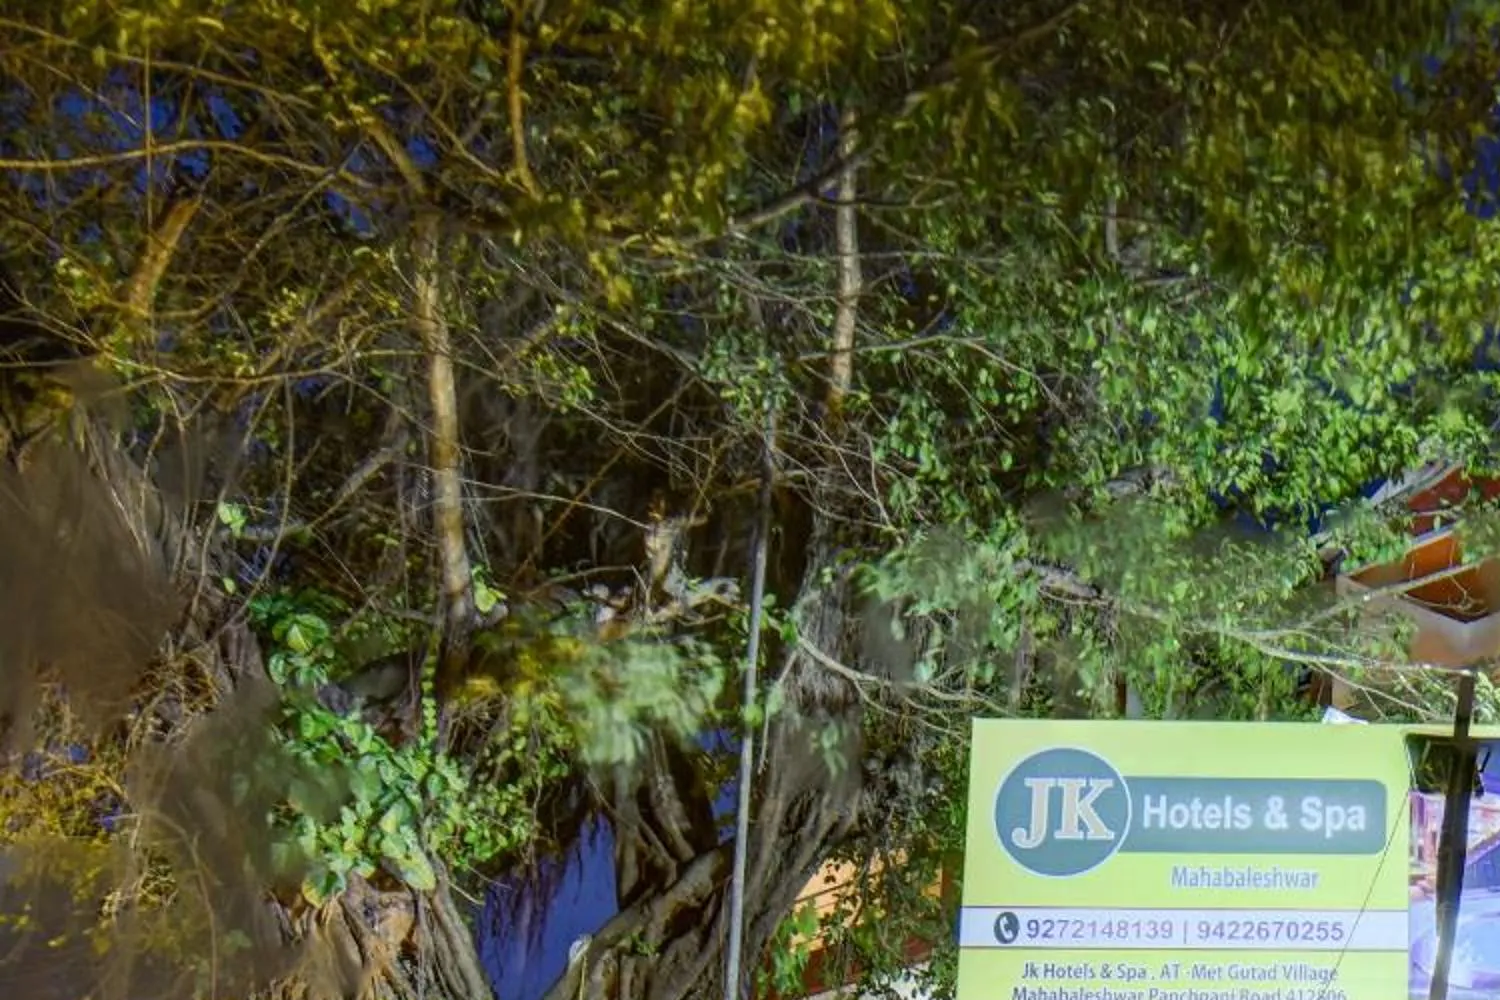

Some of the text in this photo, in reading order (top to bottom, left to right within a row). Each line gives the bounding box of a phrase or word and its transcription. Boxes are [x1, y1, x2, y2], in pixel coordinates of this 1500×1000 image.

[1011, 777, 1366, 849] JK Hotels & Spa
[1171, 865, 1319, 889] Mahabaleshwar
[1026, 918, 1174, 940] 9272148139
[1198, 921, 1345, 942] 9422670255
[1043, 962, 1095, 980] Hotels
[1100, 963, 1112, 980] &
[1117, 963, 1147, 982] Spa
[1160, 963, 1181, 980] AT
[1227, 963, 1277, 981] Gutad
[1282, 963, 1338, 984] Village
